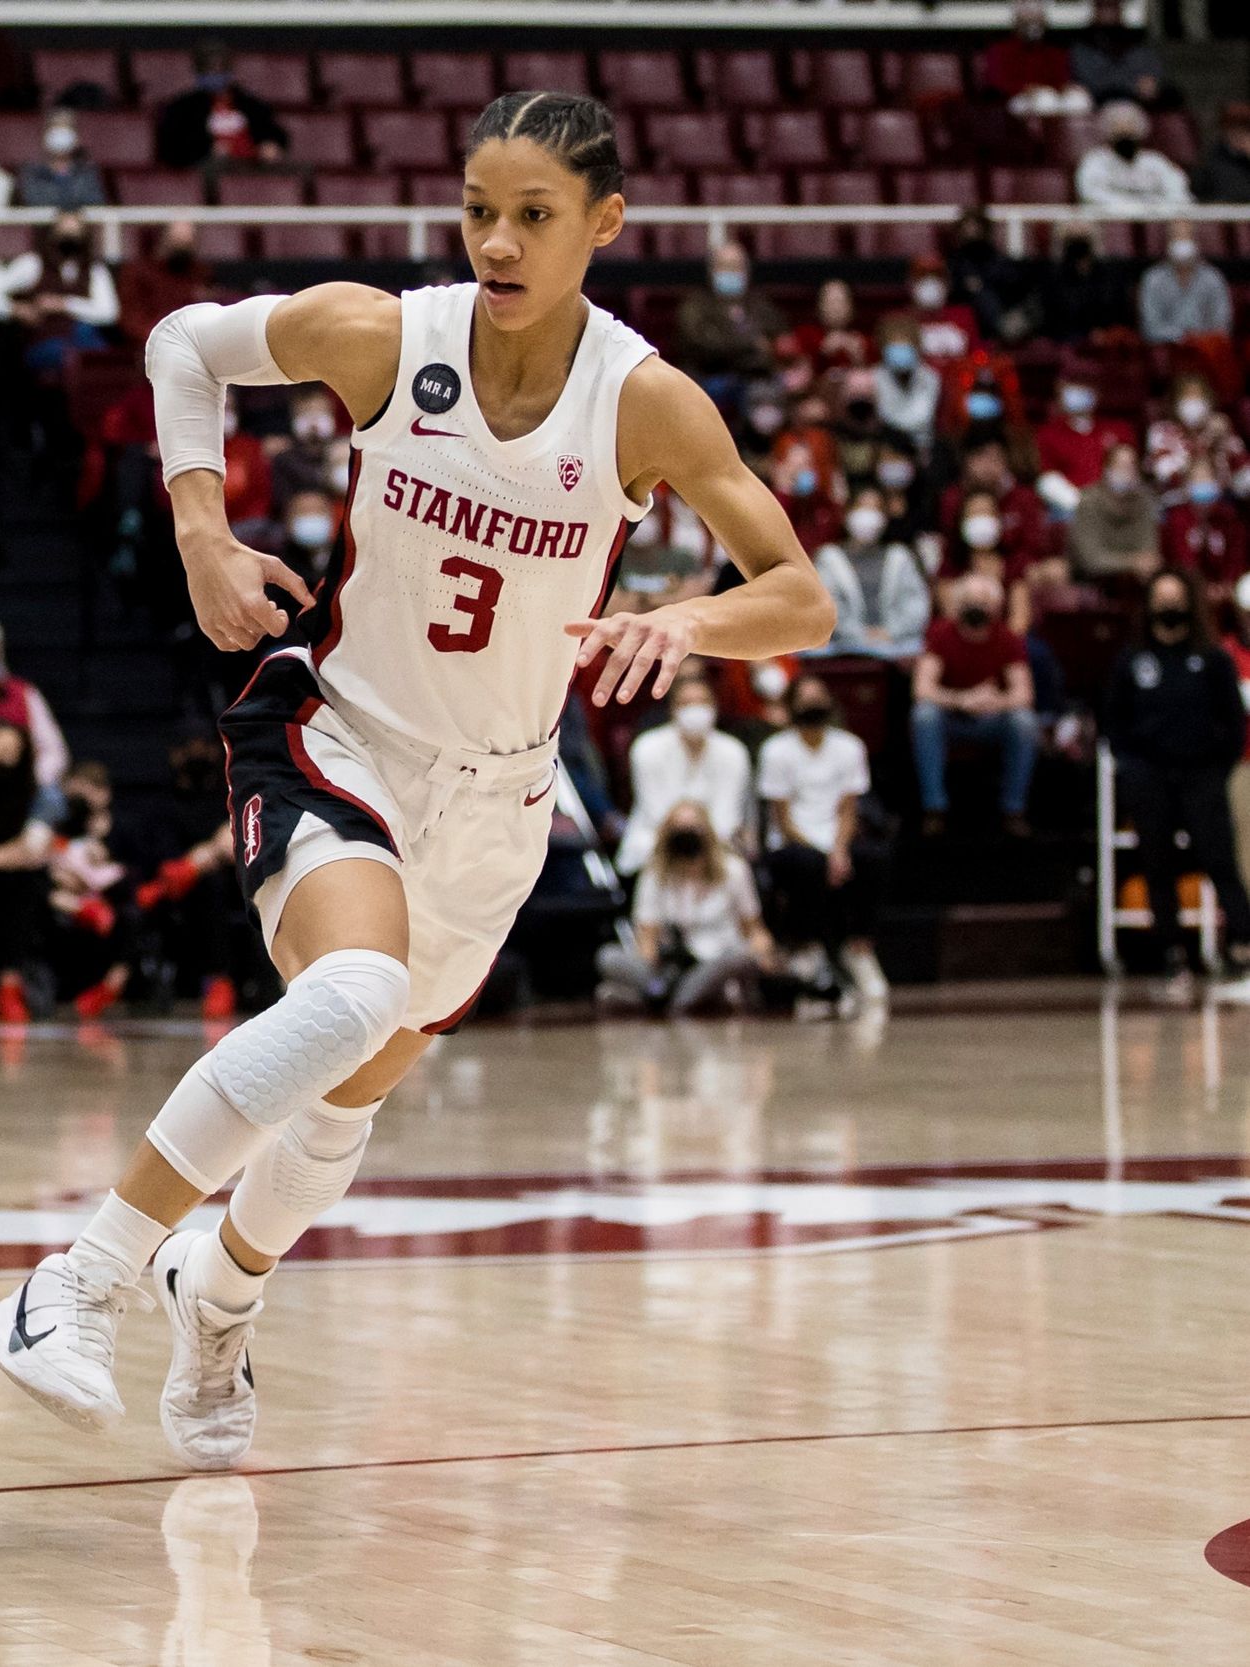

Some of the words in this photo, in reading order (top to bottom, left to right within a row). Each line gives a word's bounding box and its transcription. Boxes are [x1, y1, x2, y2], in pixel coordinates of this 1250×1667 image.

[558, 455, 583, 478] PAC
[562, 470, 576, 485] 12
[384, 468, 589, 559] STANFORD
[427, 556, 505, 653] 3
